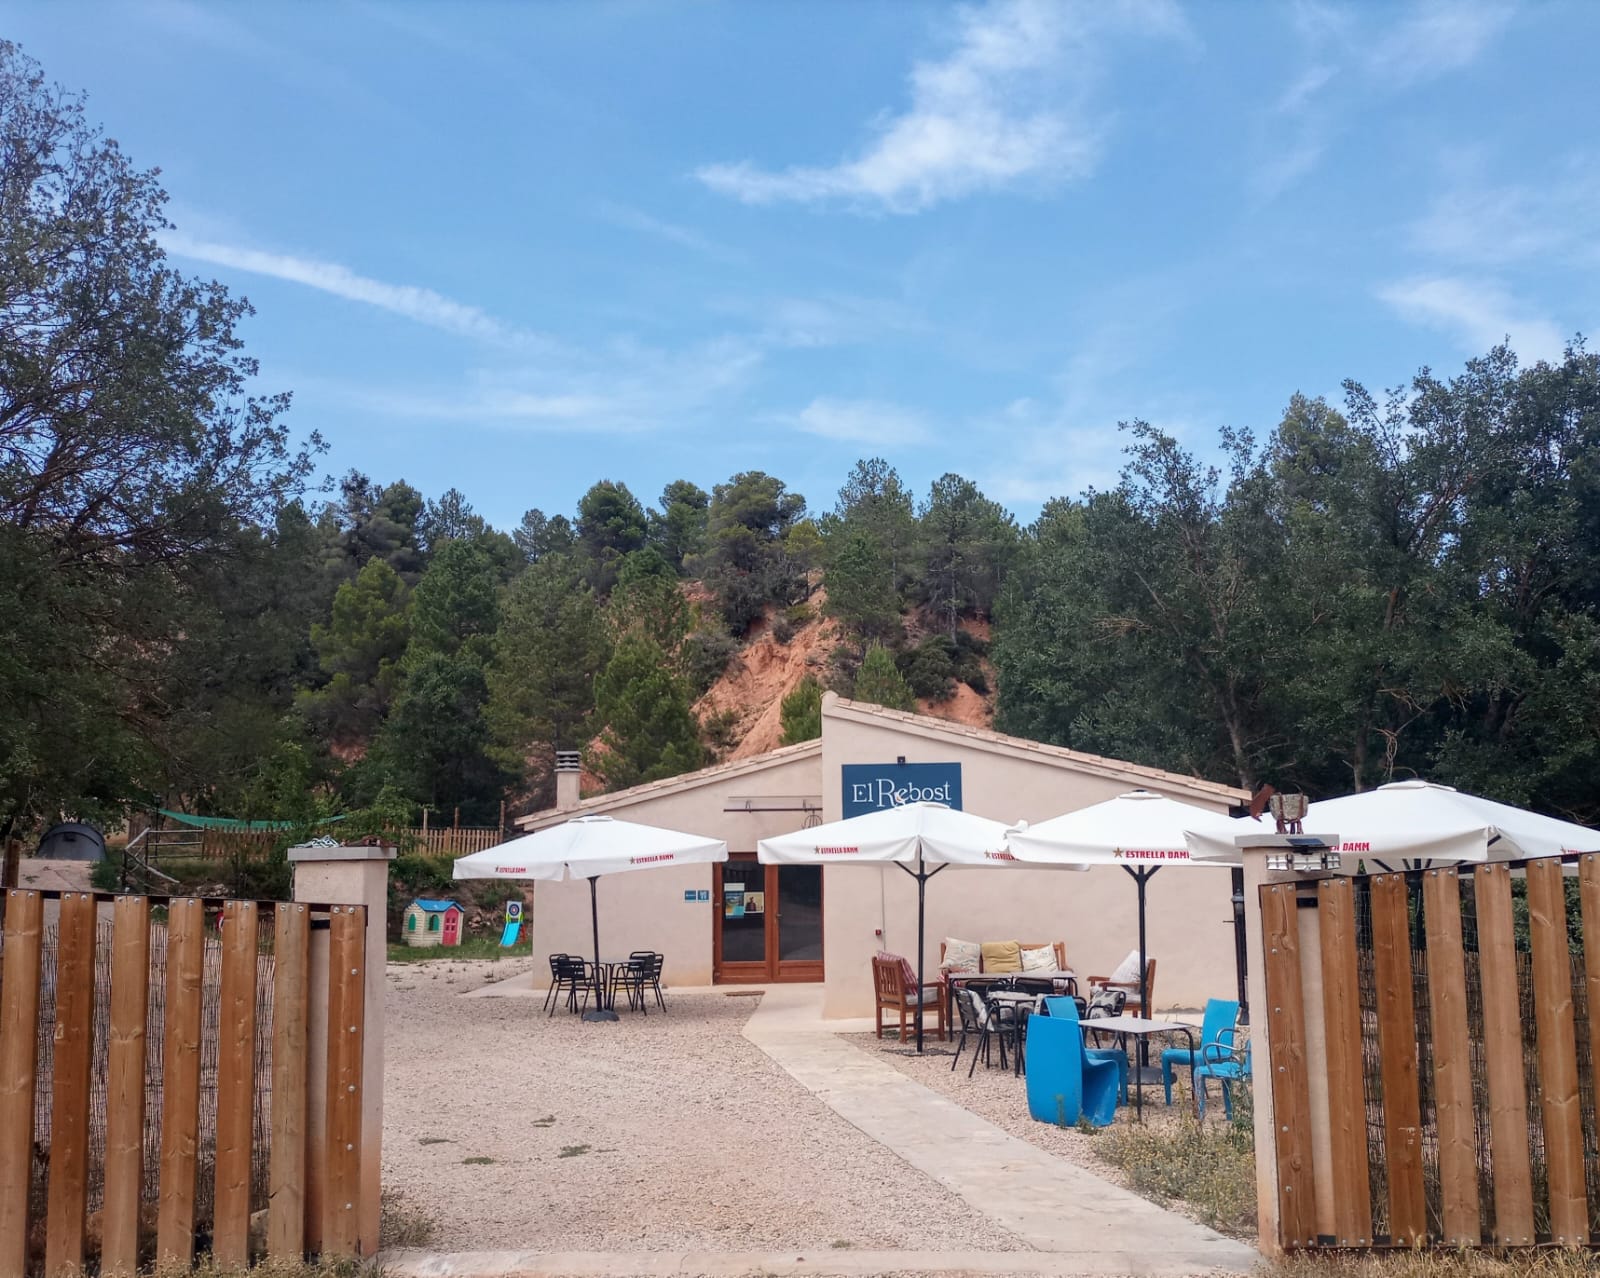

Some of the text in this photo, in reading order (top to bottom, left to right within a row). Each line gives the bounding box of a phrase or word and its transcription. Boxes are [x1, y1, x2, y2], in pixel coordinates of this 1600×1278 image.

[852, 778, 952, 808] El Rebost
[1342, 842, 1370, 852] DAMM
[1125, 850, 1165, 859] ESTRELLA
